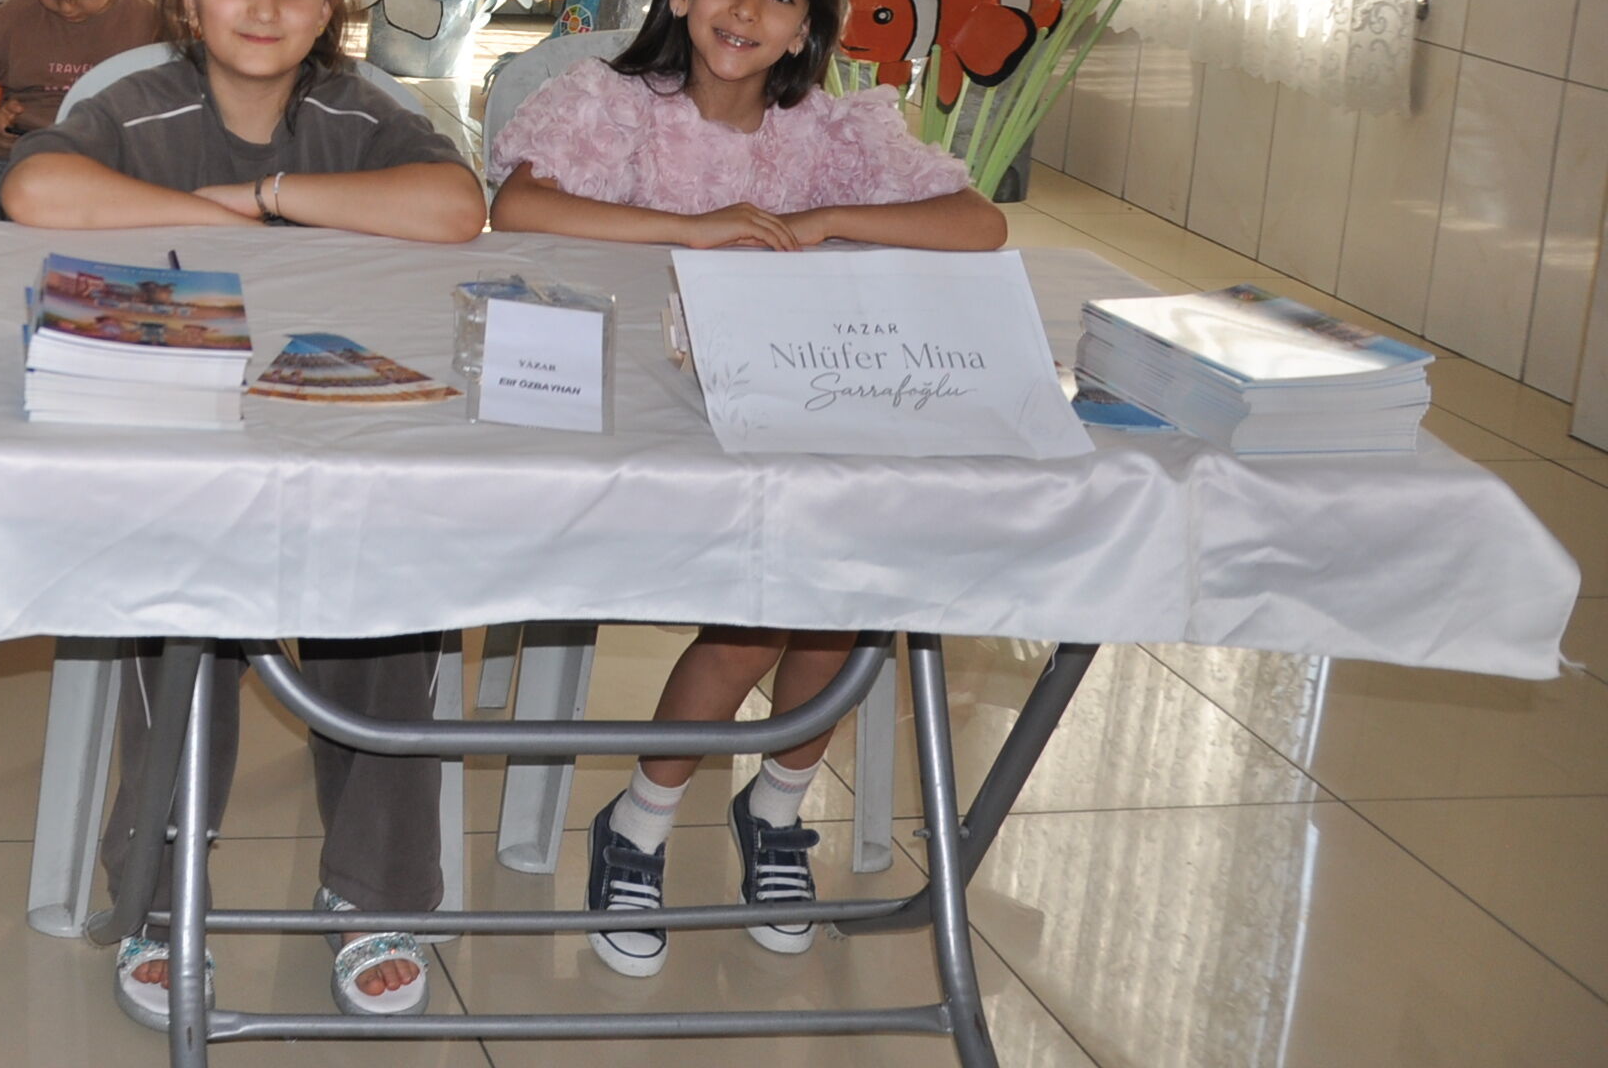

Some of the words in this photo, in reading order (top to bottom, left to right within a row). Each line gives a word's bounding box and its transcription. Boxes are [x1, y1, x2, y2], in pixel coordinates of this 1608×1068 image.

[49, 62, 93, 74] TRAVE
[833, 323, 899, 334] YAZAR
[769, 341, 887, 370] Nilüfer
[902, 342, 986, 370] Mina
[804, 372, 978, 411] Sarrafoğlu
